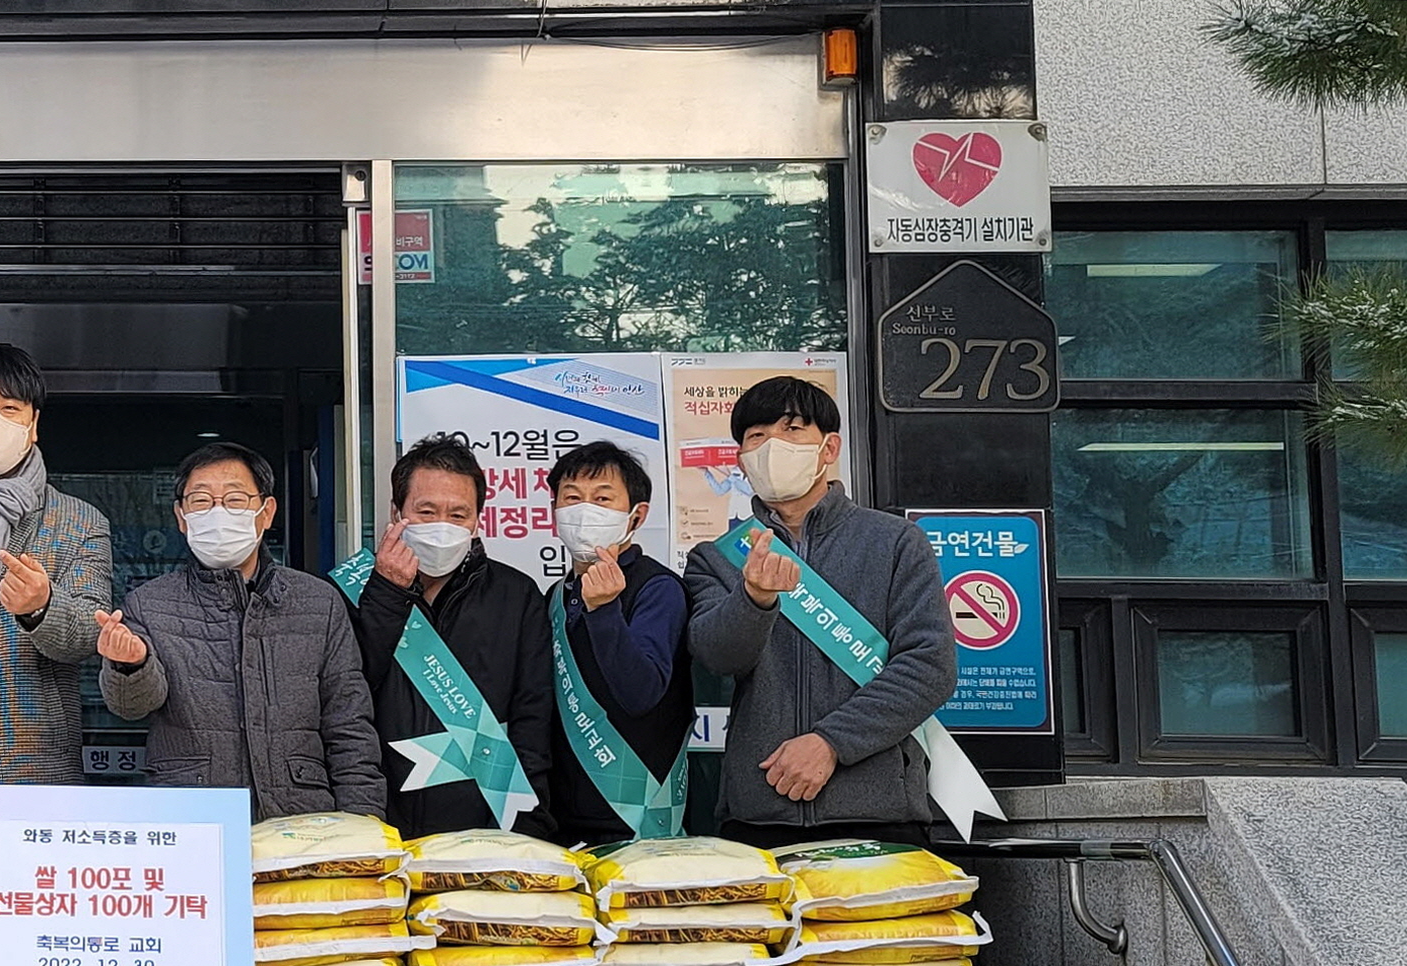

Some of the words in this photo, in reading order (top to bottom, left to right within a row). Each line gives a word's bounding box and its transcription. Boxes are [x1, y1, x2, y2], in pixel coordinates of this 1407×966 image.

[887, 217, 978, 242] 자동심장충격기
[981, 217, 1034, 242] 설치기관
[394, 253, 428, 270] OM
[920, 338, 1050, 400] 273
[684, 386, 715, 398] 세상을
[436, 429, 582, 461] 0~12월은
[926, 530, 1019, 557] 금연건물
[422, 652, 459, 692] JESUS
[446, 684, 477, 721] LOVE
[90, 750, 137, 770] 행정
[23, 828, 53, 844] 와동
[62, 829, 138, 845] 저소득증을
[146, 831, 177, 846] 위한
[35, 865, 57, 890] 쌀
[67, 866, 133, 891] 100포
[143, 867, 165, 892] 및
[88, 894, 153, 919] 100개
[164, 894, 208, 920] 기탁
[36, 935, 120, 953] 축복의통로
[129, 937, 161, 954] 교회
